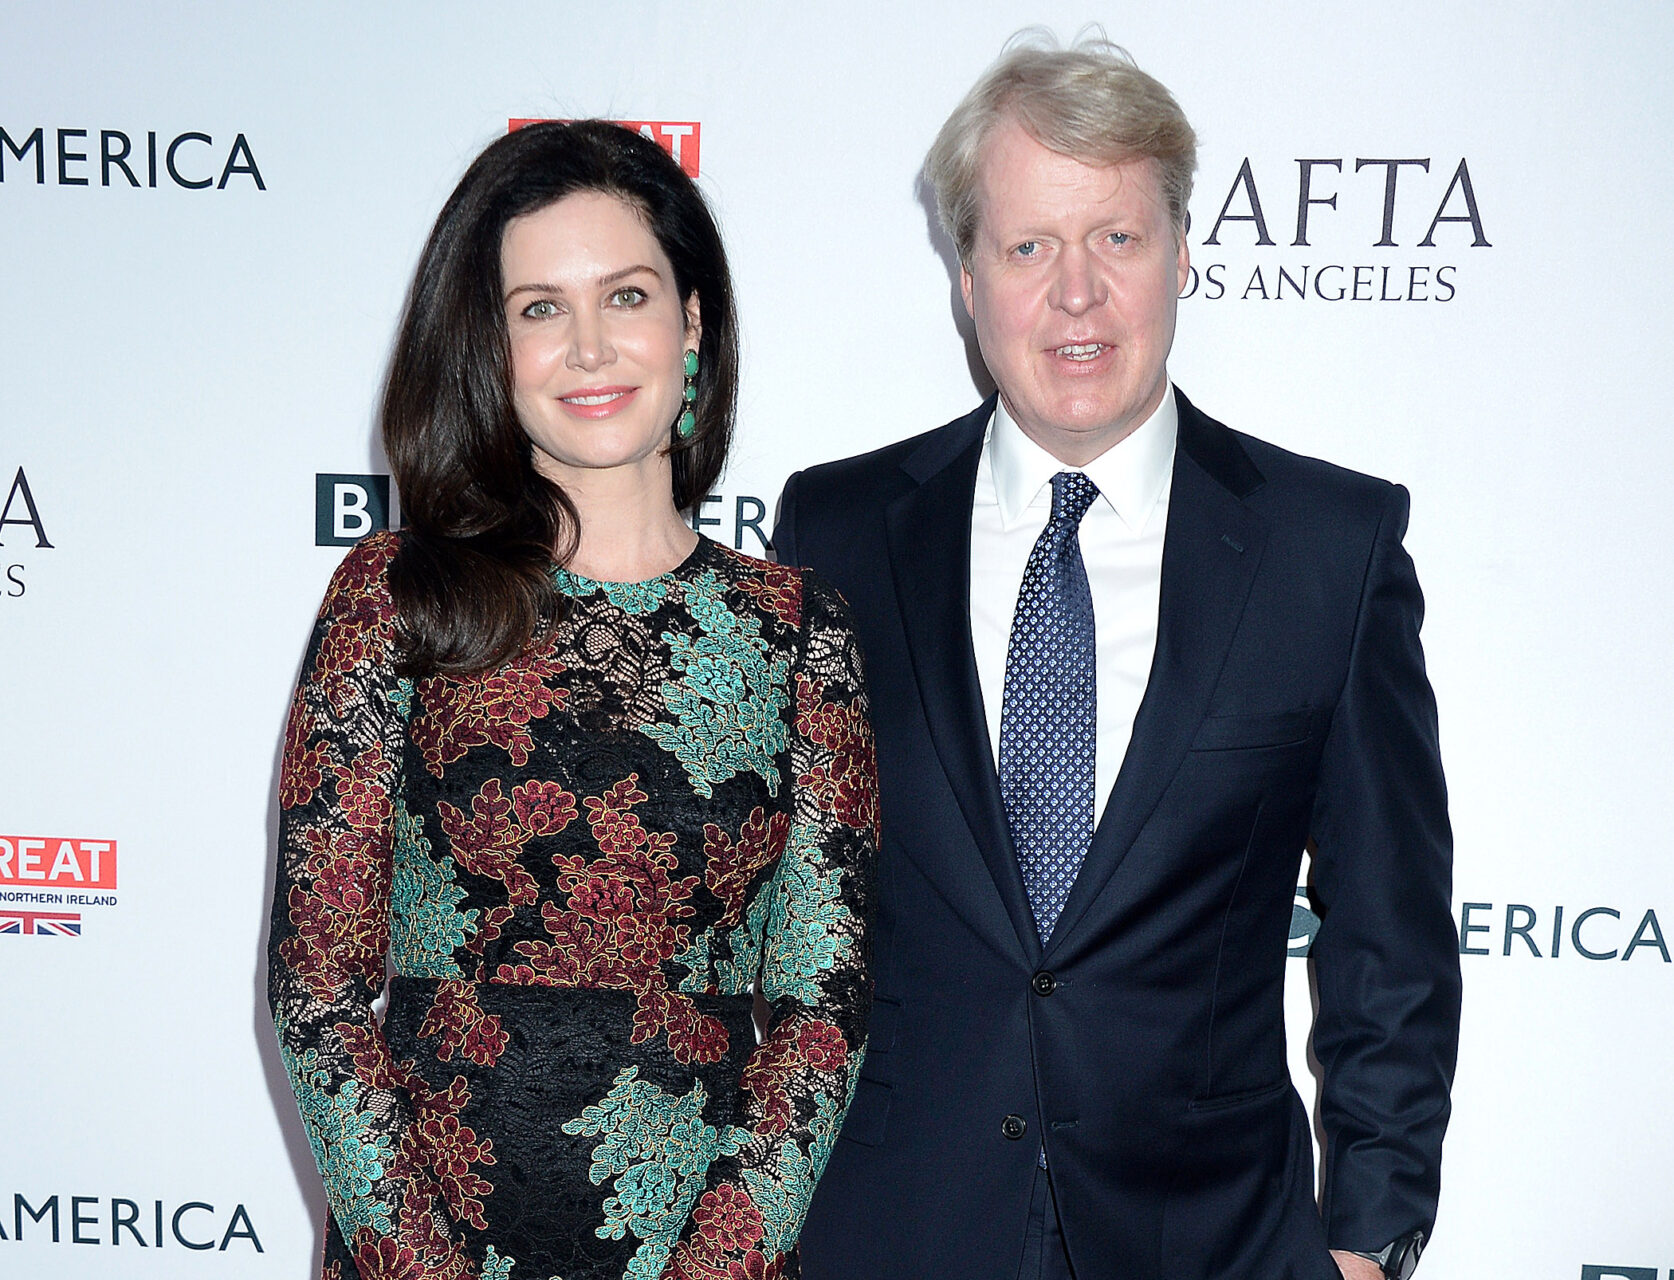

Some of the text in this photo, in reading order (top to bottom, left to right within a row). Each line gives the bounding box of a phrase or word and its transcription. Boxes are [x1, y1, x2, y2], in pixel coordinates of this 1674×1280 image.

[1185, 155, 1493, 248] AFTA
[1240, 264, 1457, 302] ANGELES
[0, 891, 118, 906] NORTHERN IRELAND
[1459, 902, 1672, 963] ERICA
[0, 1193, 265, 1253] MERICA
